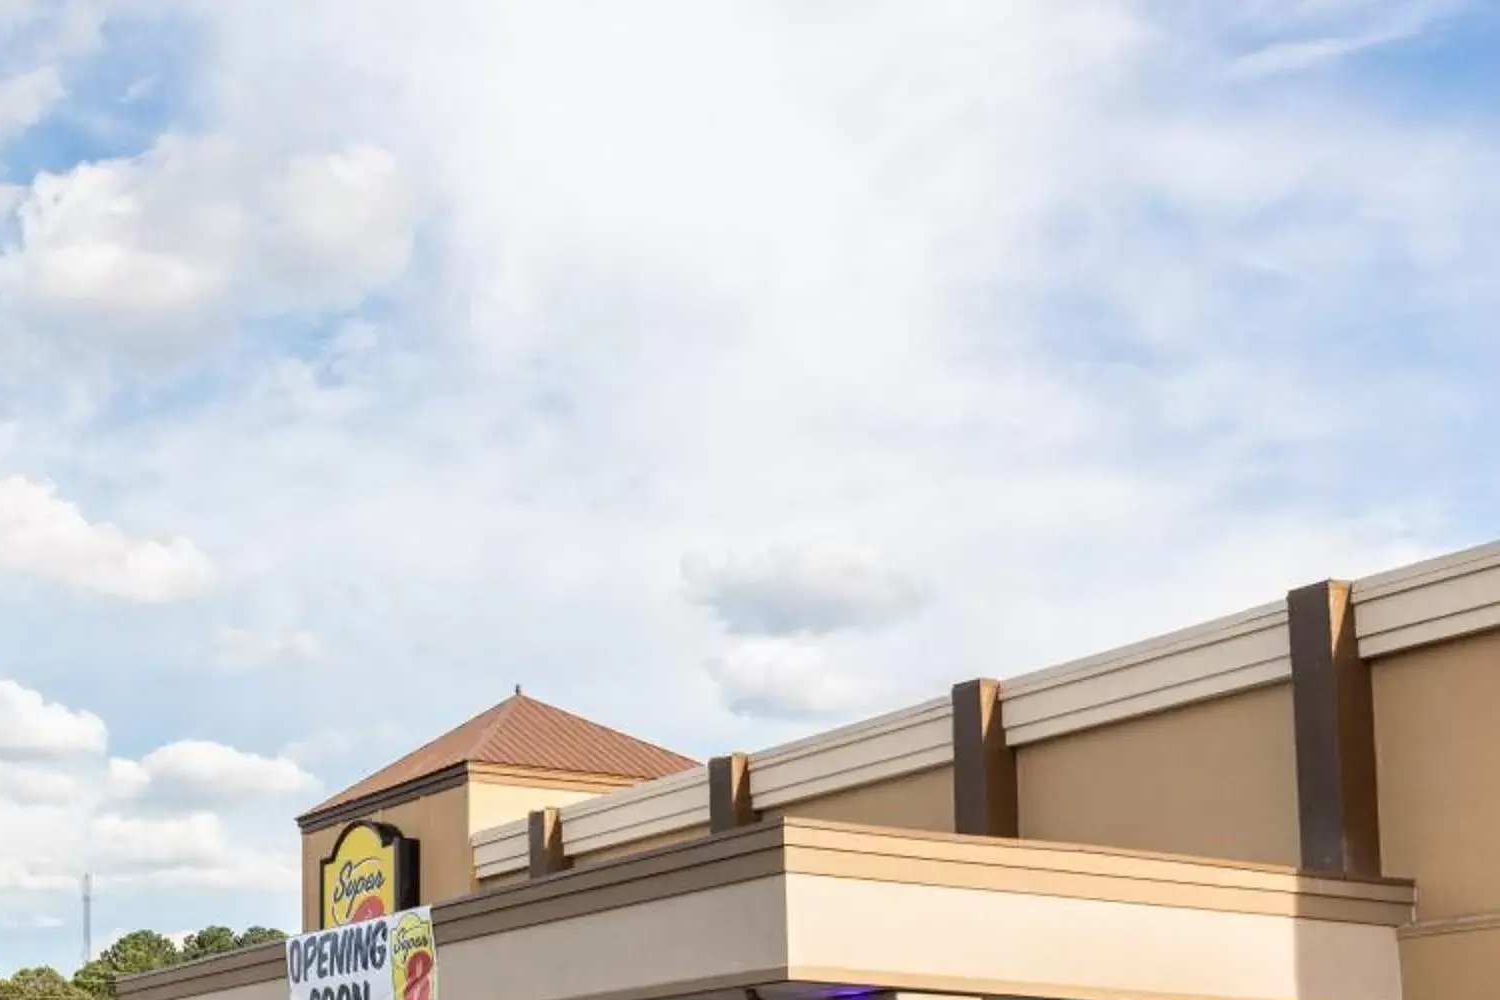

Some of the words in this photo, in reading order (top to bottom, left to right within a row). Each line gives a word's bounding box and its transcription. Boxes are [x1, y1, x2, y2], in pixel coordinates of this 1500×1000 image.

[333, 858, 386, 918] Super
[289, 920, 388, 984] OPENING
[393, 928, 429, 962] Super
